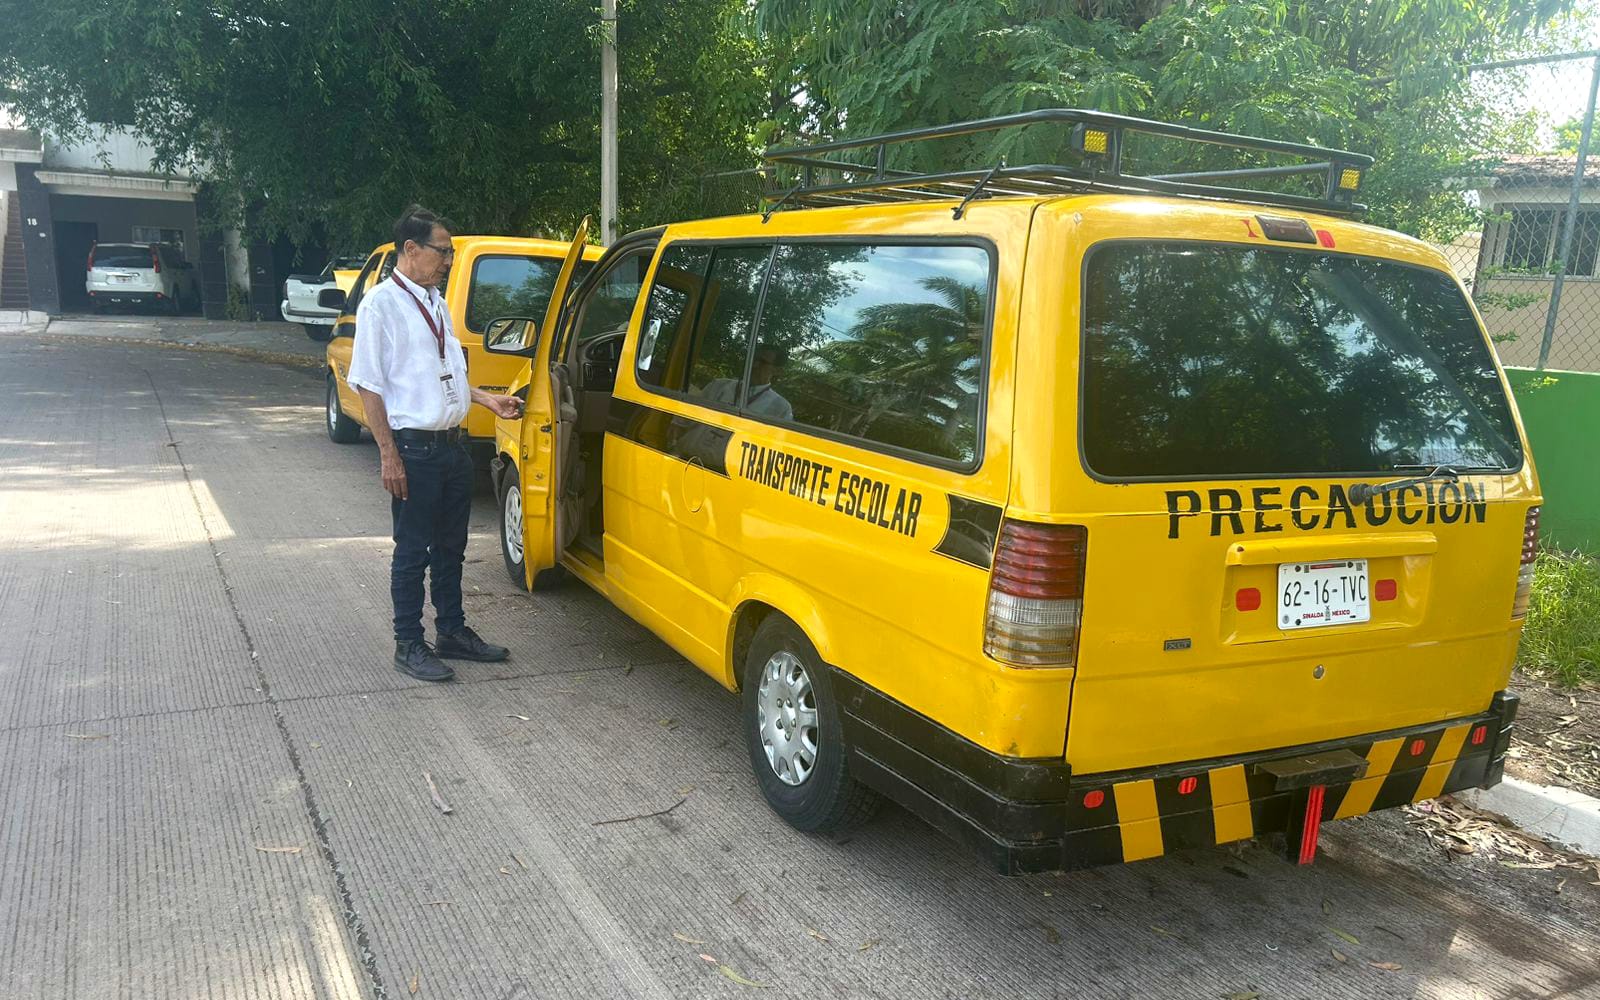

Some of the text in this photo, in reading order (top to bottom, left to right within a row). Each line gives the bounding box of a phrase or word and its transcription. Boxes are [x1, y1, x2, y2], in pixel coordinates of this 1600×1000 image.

[738, 441, 922, 538] TRANSPORTE ESCOLAR
[1283, 575, 1367, 607] 62-16-TVC
